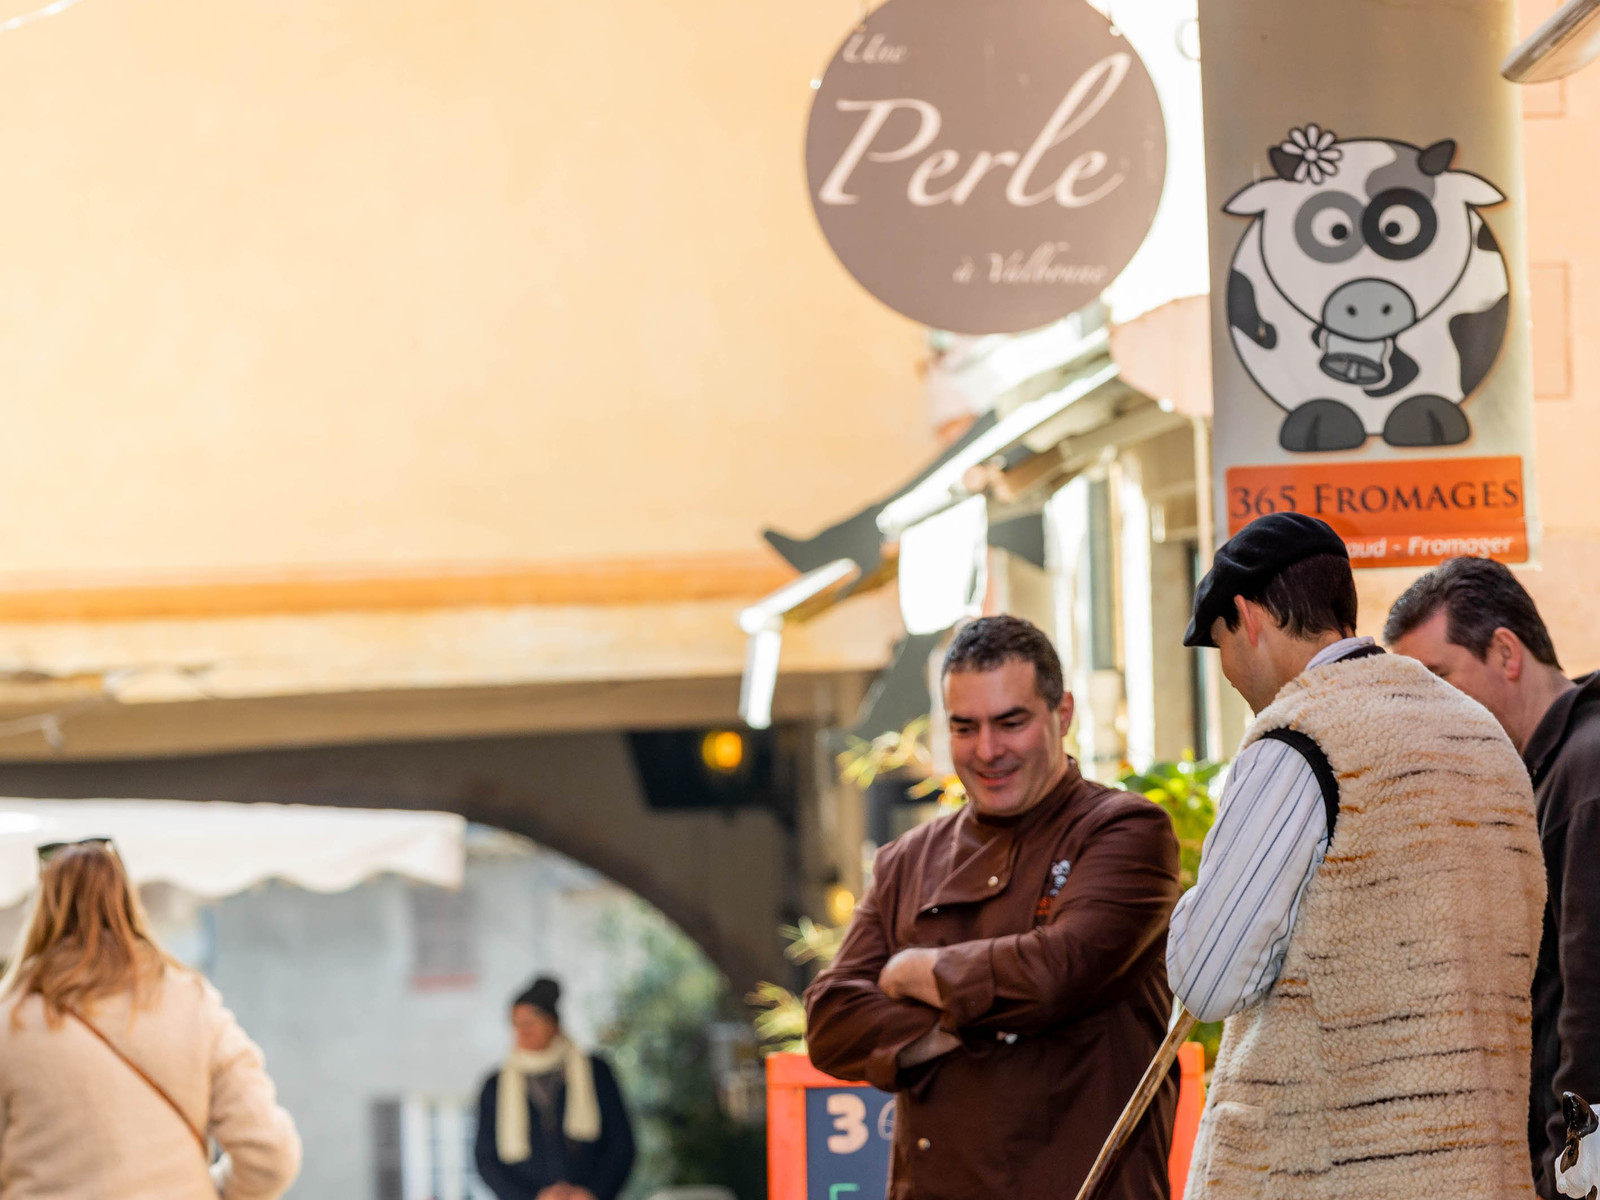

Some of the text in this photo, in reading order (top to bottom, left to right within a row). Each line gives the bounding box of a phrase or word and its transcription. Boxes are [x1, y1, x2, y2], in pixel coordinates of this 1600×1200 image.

[818, 52, 1132, 208] Perle
[1231, 479, 1520, 519] 365 FROMAGES
[1408, 535, 1514, 559] Fromager
